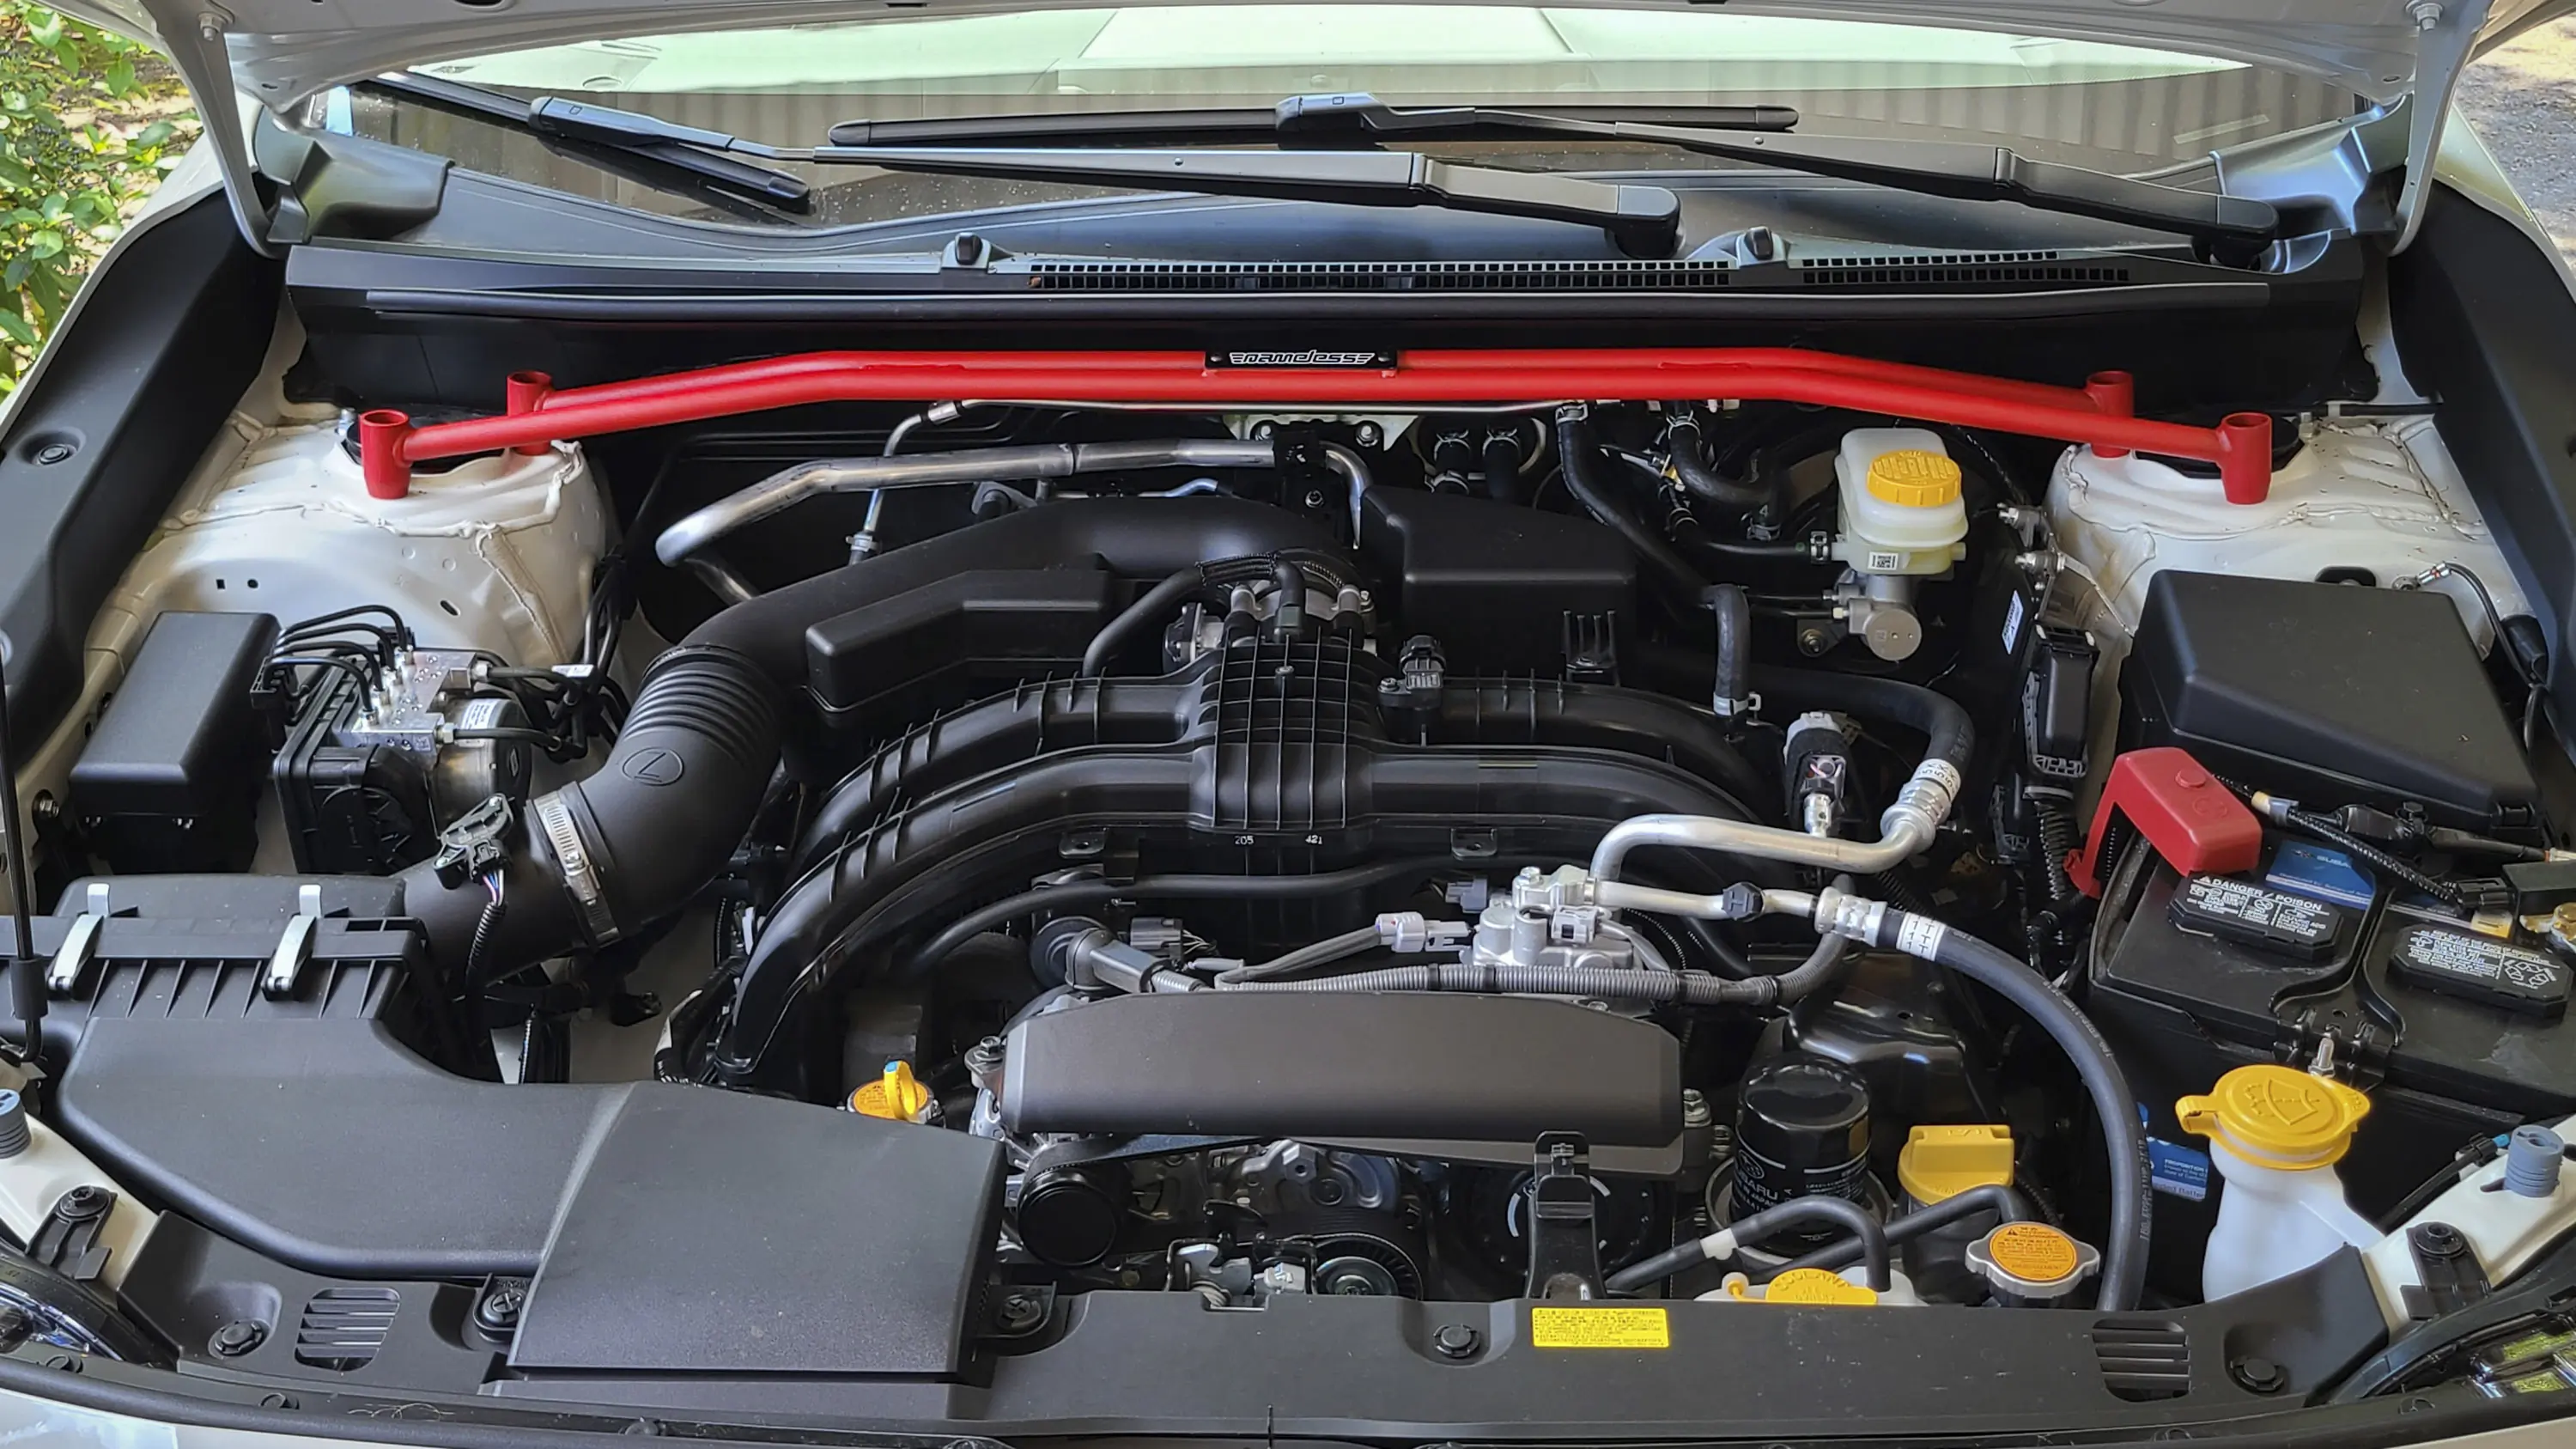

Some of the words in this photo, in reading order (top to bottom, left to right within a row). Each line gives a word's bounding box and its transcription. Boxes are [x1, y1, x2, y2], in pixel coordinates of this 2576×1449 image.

[1237, 349, 1367, 365] nameless
[2317, 855, 2352, 868] SUBA
[2212, 878, 2263, 898] DANGER
[2275, 893, 2323, 910] POISON
[1774, 1270, 1851, 1291] COOLANT
